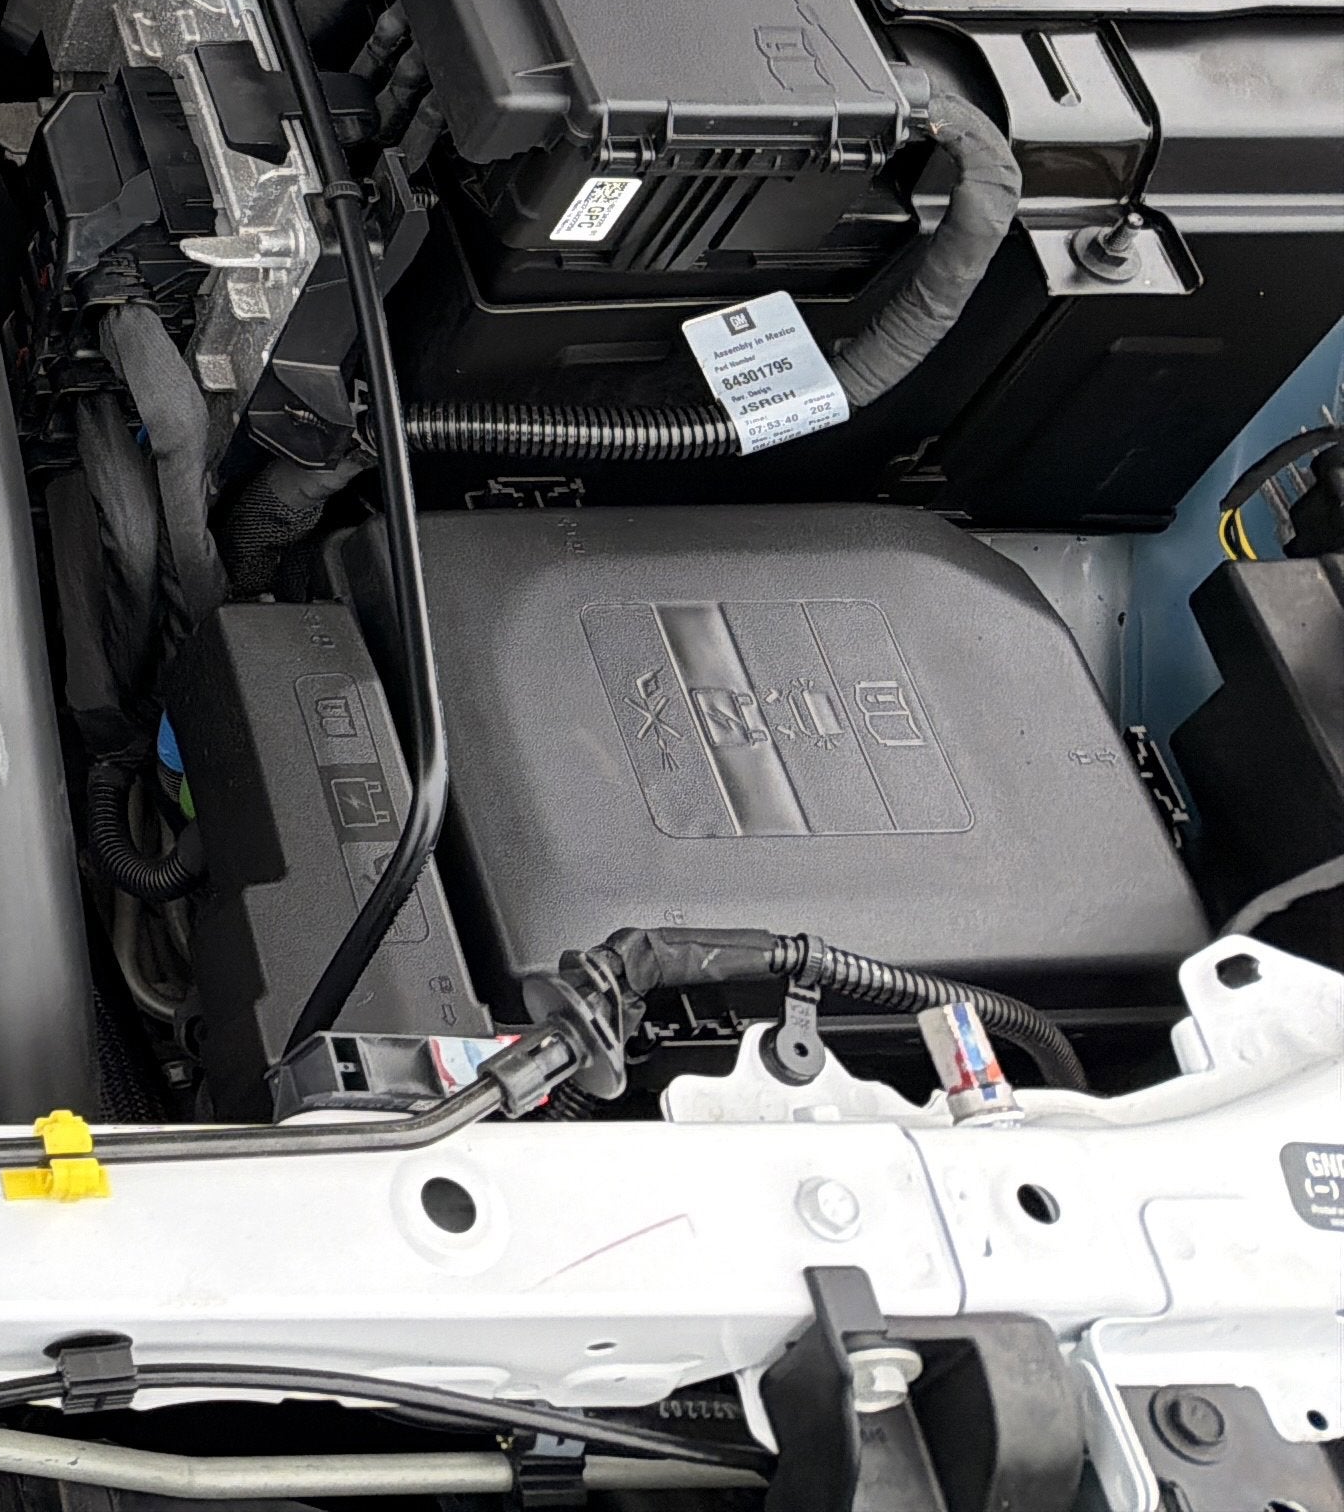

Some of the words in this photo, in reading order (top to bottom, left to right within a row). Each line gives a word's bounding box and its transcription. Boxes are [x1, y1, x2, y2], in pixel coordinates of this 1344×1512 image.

[577, 206, 605, 228] GPC
[730, 313, 749, 330] GM
[714, 340, 753, 360] Assembly
[756, 337, 765, 345] in
[765, 326, 796, 341] Mexico
[714, 364, 729, 373] Part
[729, 355, 755, 369] Number
[721, 357, 793, 391] 84301795
[739, 390, 796, 415] JSRGH
[748, 414, 799, 436] 07:53:40
[809, 402, 832, 415] 202
